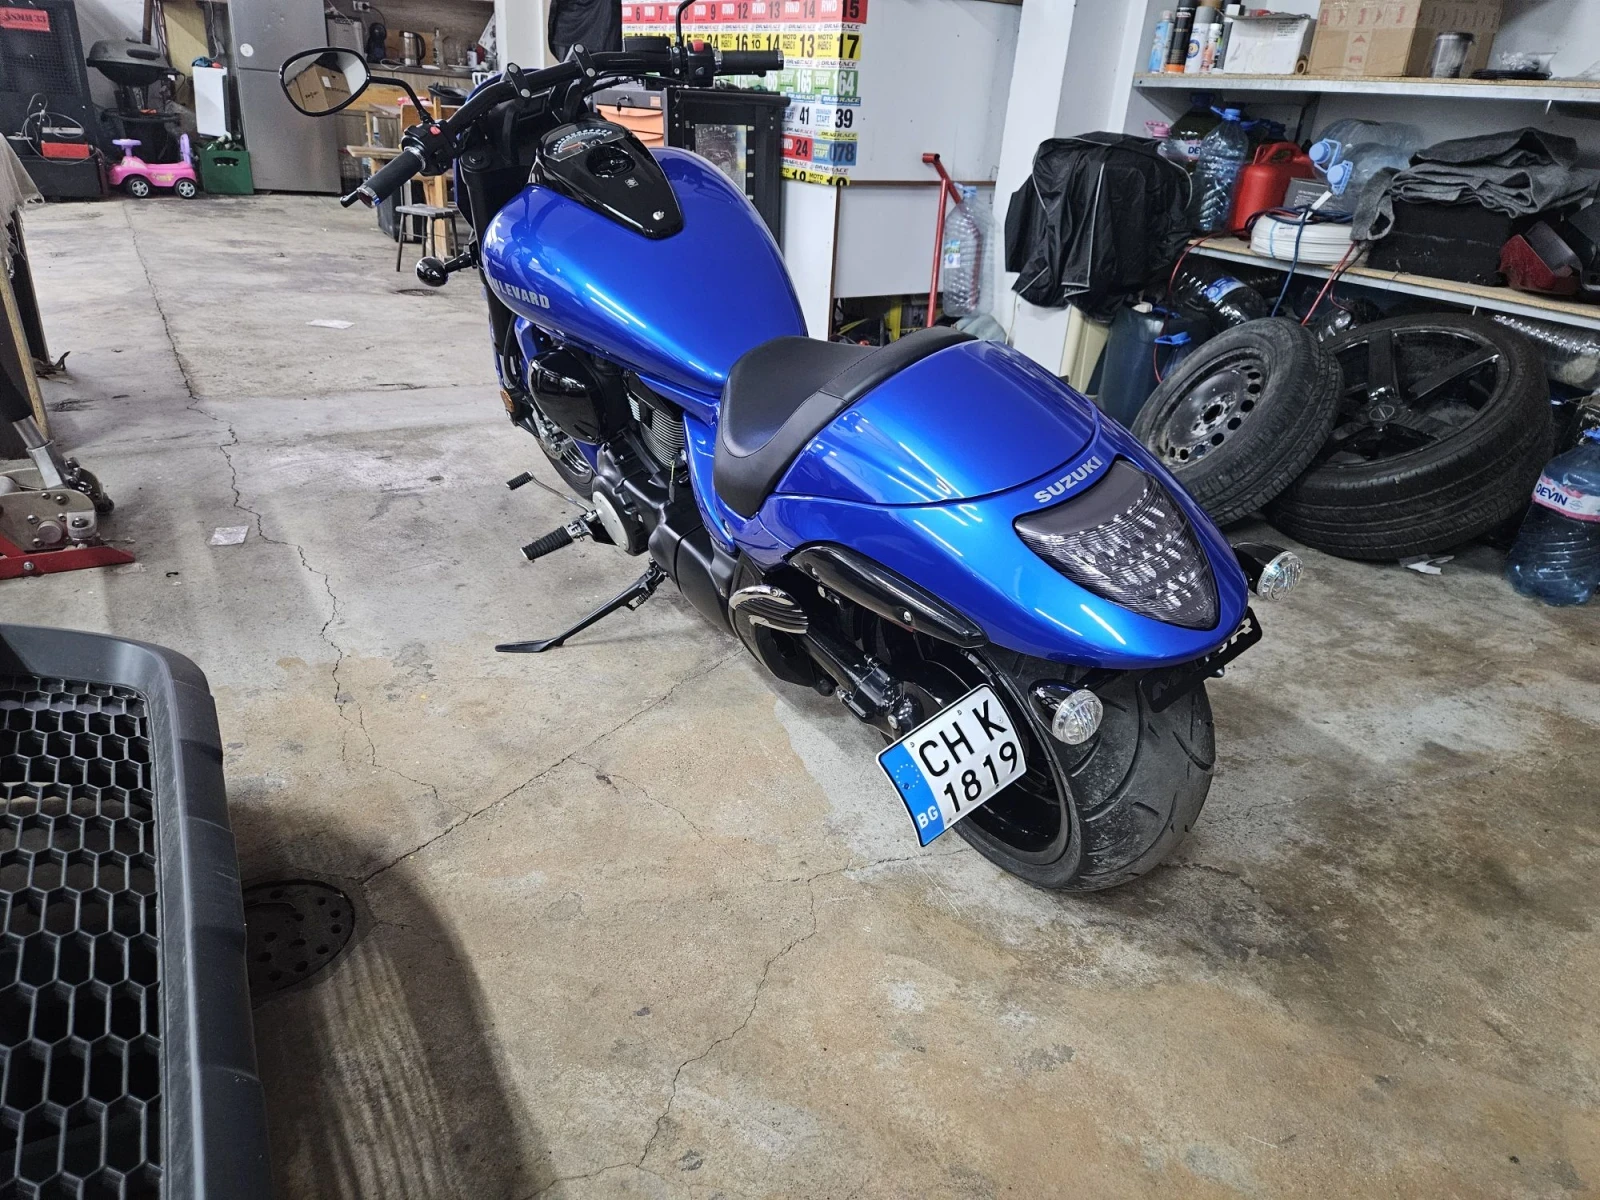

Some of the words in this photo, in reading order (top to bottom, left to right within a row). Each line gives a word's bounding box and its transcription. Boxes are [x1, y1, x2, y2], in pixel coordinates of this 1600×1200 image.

[738, 3, 748, 19] 12
[769, 1, 780, 19] 13
[803, 0, 816, 18] 14
[841, 0, 860, 19] 15
[736, 33, 748, 50] 16
[766, 33, 780, 50] 14
[800, 33, 815, 58] 13
[837, 33, 860, 59] 17
[799, 106, 810, 125] 41
[835, 108, 853, 128] 39
[795, 139, 808, 157] 24
[829, 142, 855, 162] 078
[1034, 455, 1103, 503] SUZUKI
[1536, 483, 1568, 506] DEVIN
[918, 721, 975, 777] CH
[972, 699, 1007, 742] K
[943, 741, 1018, 813] 1819
[917, 806, 939, 829] BG
